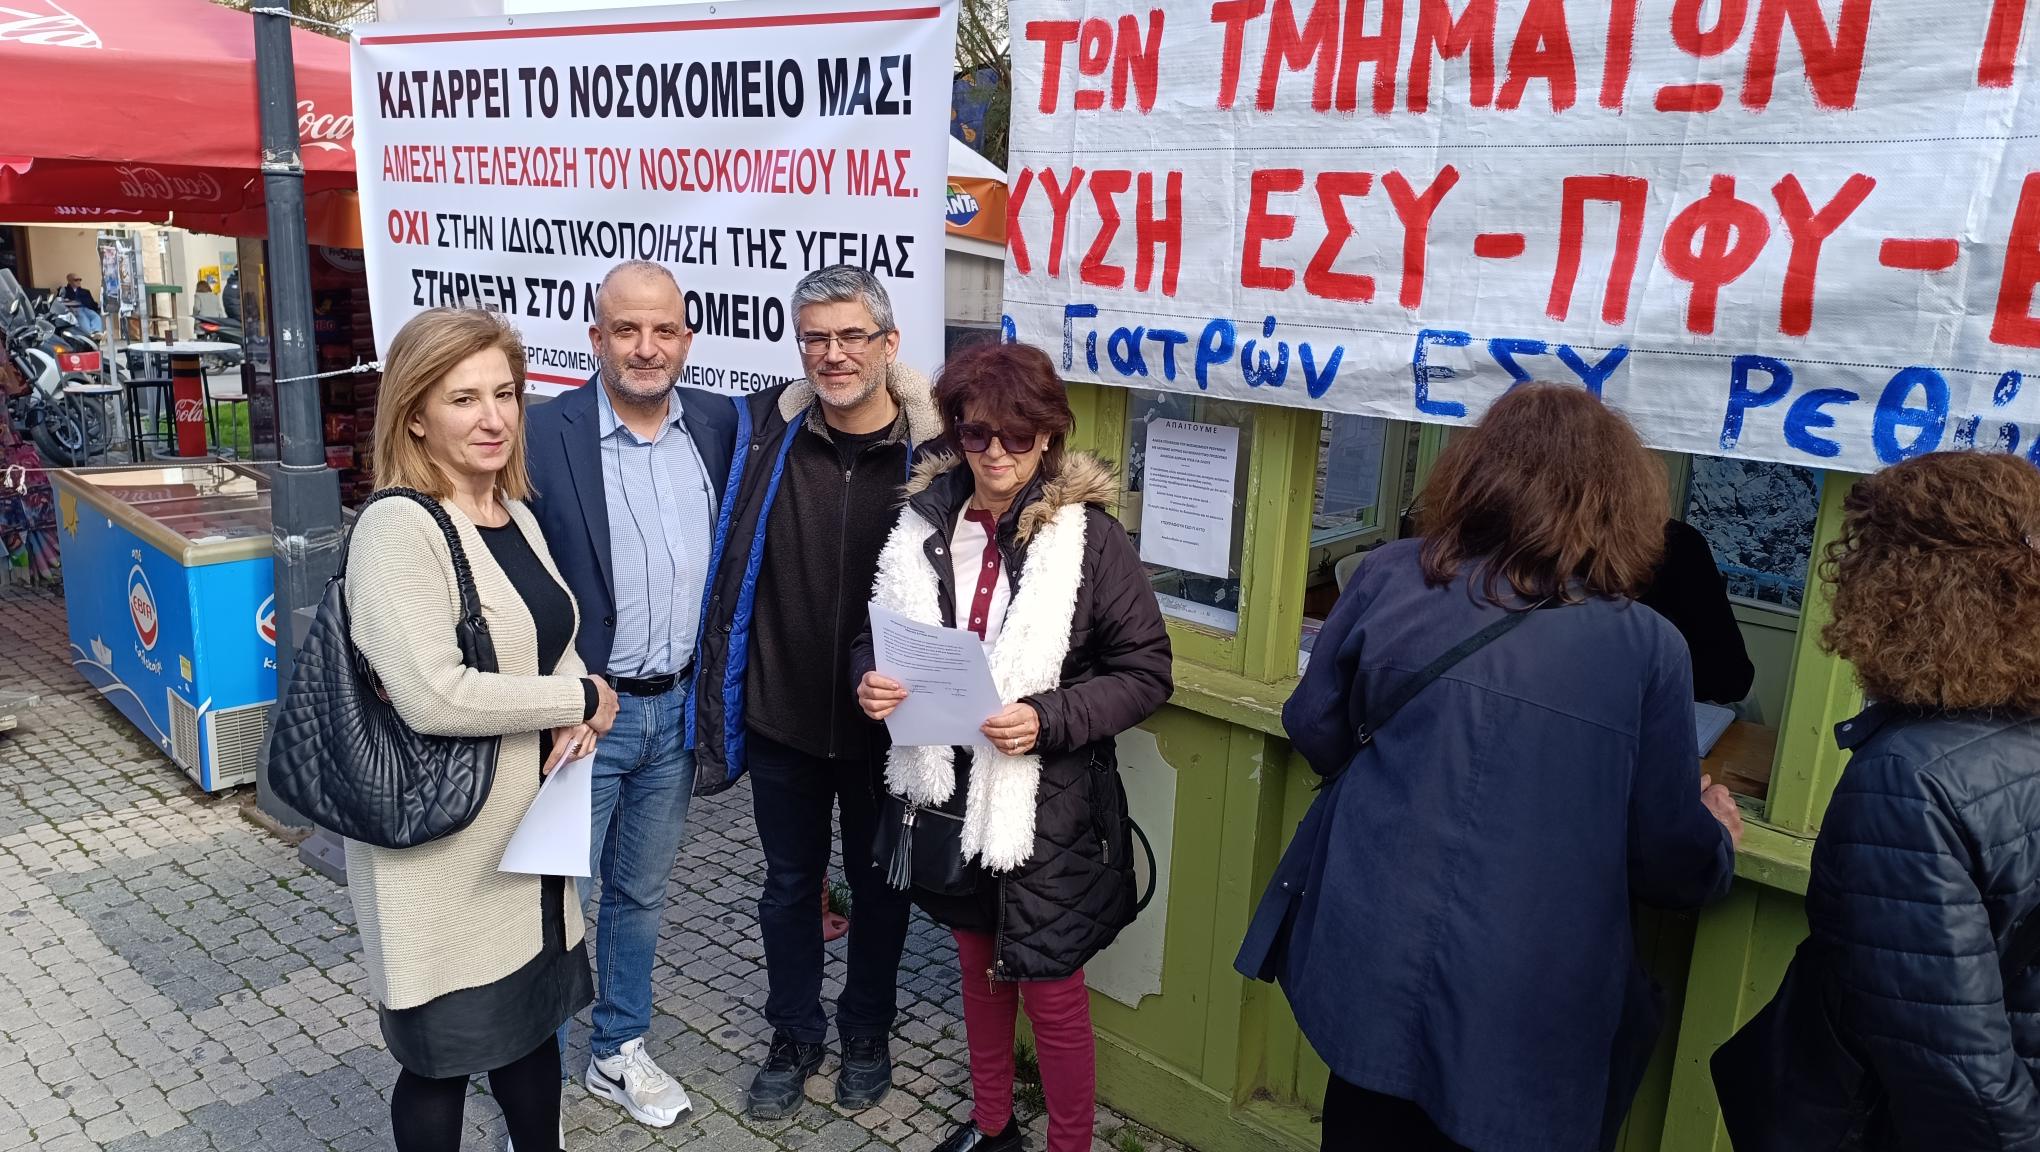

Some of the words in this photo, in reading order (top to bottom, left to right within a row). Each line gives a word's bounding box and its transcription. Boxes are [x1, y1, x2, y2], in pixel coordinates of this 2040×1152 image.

[377, 69, 508, 118] ΚΑΤΑΡΡΕΙ
[519, 67, 557, 118] ΤΟ
[570, 59, 804, 118] ΝΟΣΟΚΟΜΕΙΟ
[819, 54, 912, 116] ΜΑΣ!
[1025, 8, 1165, 115] ΤΩΝ
[383, 146, 446, 183] ΑΜΕΣΗ
[453, 146, 578, 188] ΣΤΕΛΕΧΩΣΗ
[584, 148, 630, 189] ΤΟΥ
[640, 149, 836, 195] ΝΟΣΟΚΟΜΕΙΟΥ
[847, 149, 919, 198] ΜΑΣ.
[946, 194, 979, 215] ANTA
[388, 209, 429, 245] ΟΧΙ
[437, 213, 493, 251] ΣΤΗΝ
[502, 218, 716, 265] ΙΔΙΩΤΙΚΟΠΟΙΗΣΗ
[727, 227, 786, 270] ΤΗΣ
[796, 230, 914, 278] ΥΓΕΙΑΣ
[1240, 164, 1460, 311] ΕΣΥ
[1545, 173, 1877, 337] ΠΦΥ
[412, 269, 517, 314] ΣΤΗΡΙΞΗ
[525, 277, 574, 320] ΣΤΟ
[584, 283, 784, 342] ΝΟΜΕΙΟ
[680, 365, 725, 388] ΜΕΙΟΥ
[1062, 303, 1344, 399] Γιατρών
[1719, 354, 2040, 465] Ρεθύ
[1165, 421, 1218, 434] ΑΠΑΙΤΟΥΜΕ
